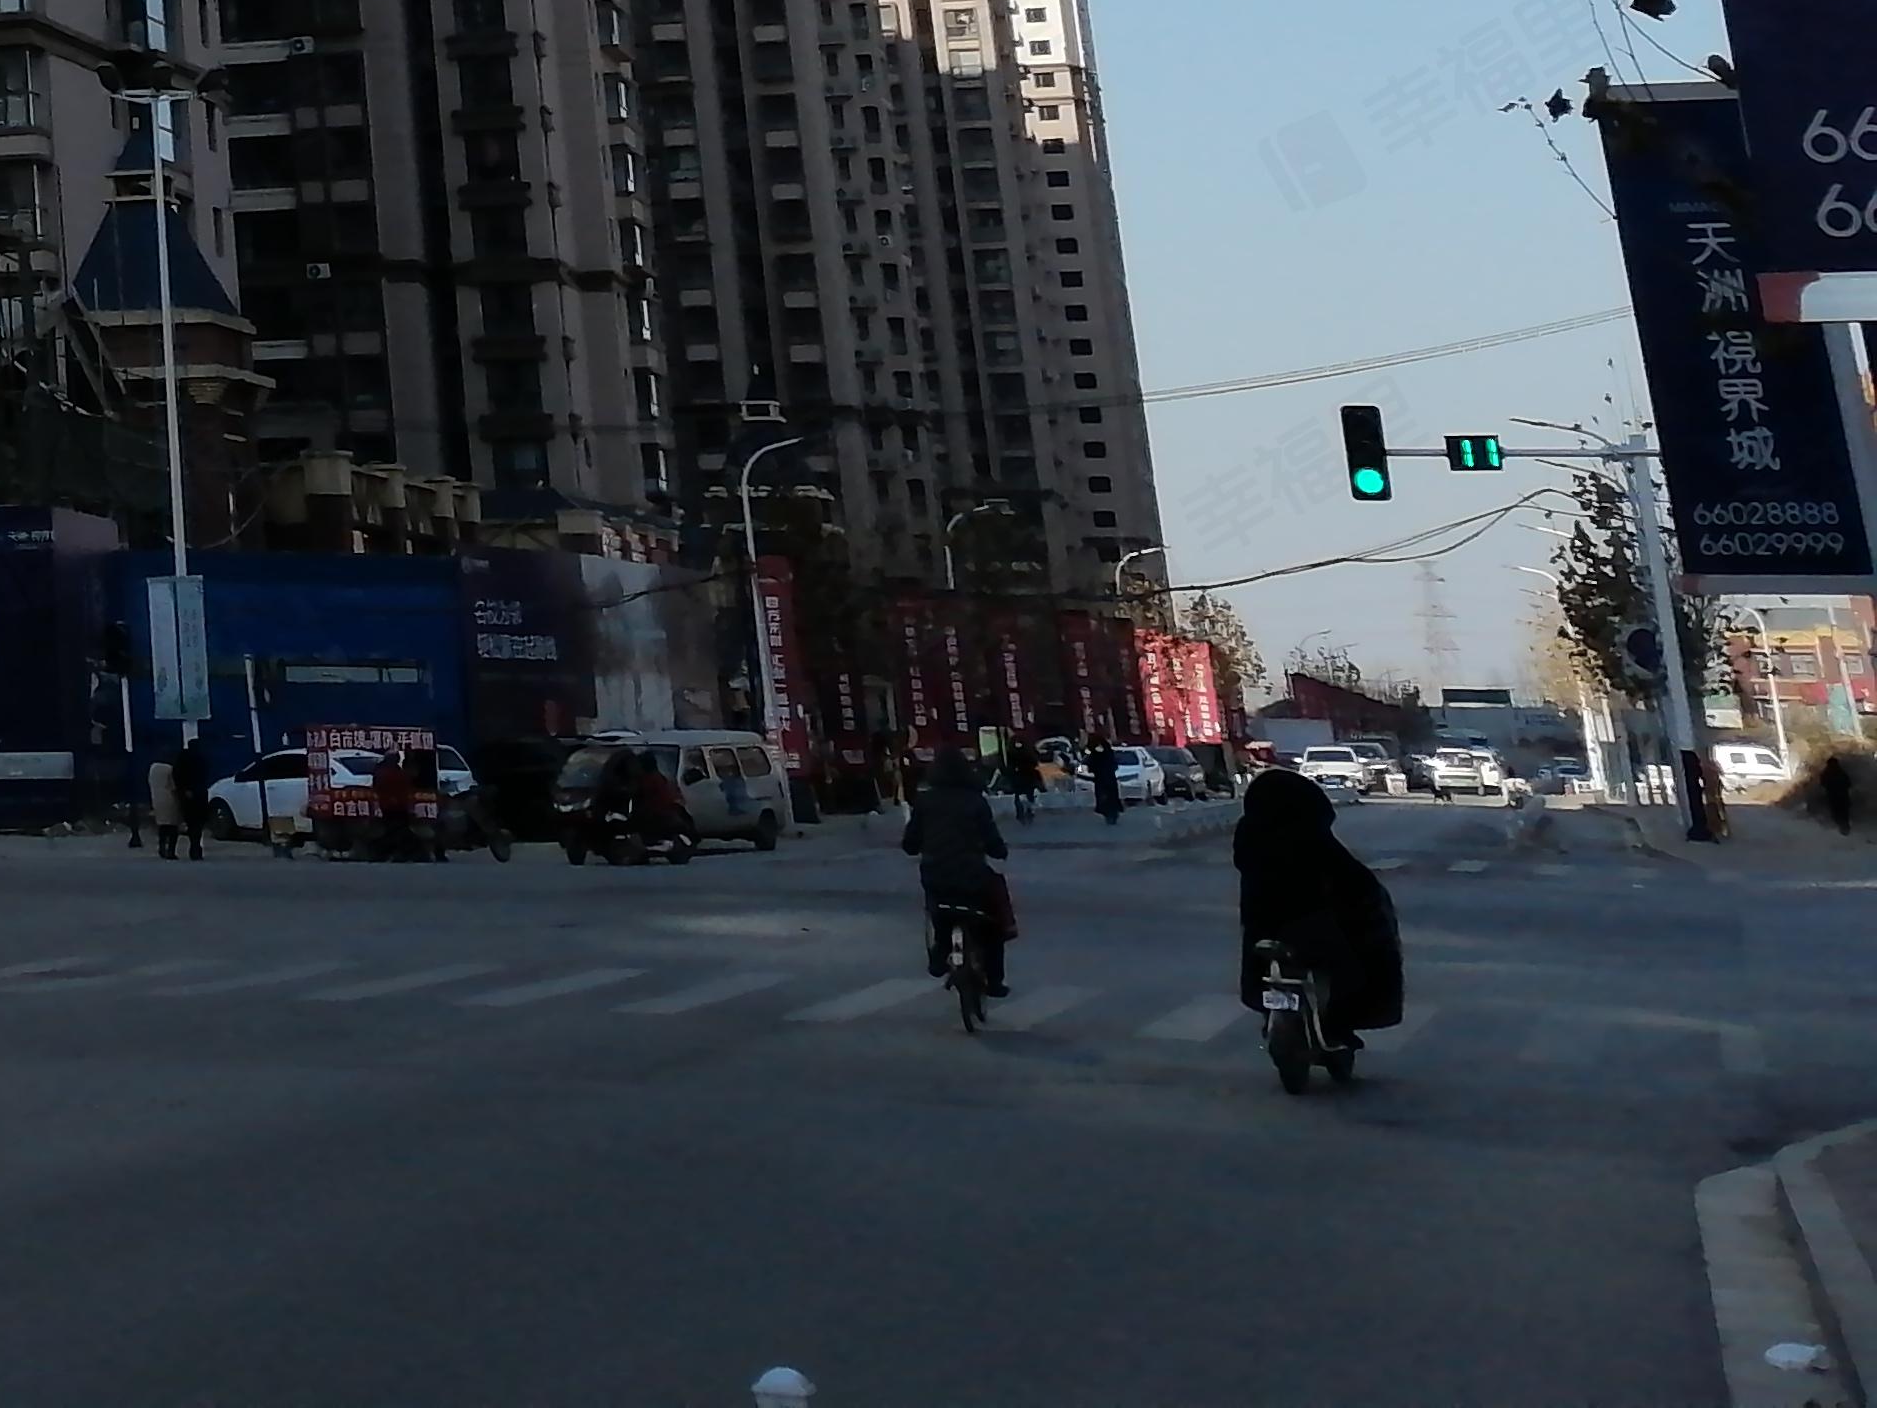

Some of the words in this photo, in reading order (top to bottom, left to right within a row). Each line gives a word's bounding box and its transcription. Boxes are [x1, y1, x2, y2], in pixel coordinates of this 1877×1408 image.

[1817, 183, 1877, 237] 6
[1693, 501, 1840, 526] 66028888
[1700, 532, 1845, 556] 66029999
